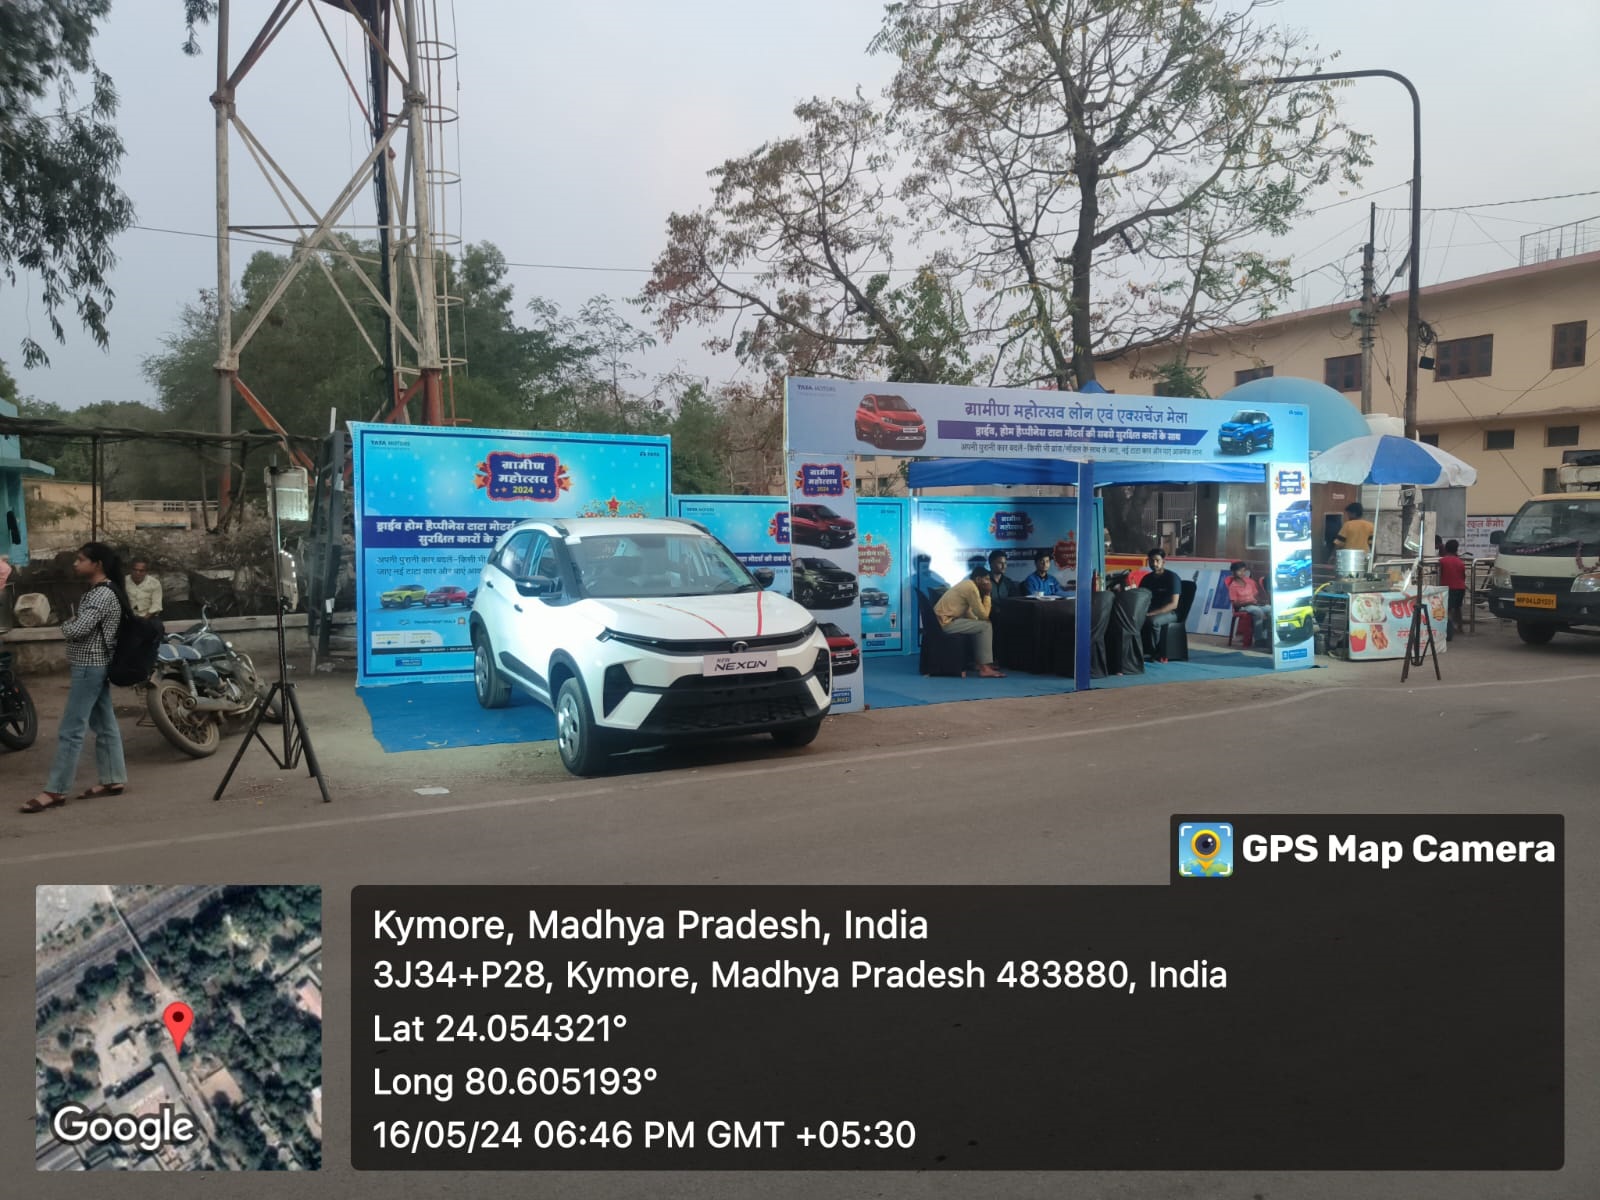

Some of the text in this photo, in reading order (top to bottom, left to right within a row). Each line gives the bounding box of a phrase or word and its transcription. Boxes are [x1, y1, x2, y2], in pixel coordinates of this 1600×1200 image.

[965, 398, 1188, 425] ग्रामीण महोत्सव लोन एवं एक्सचेंज मेला
[502, 459, 545, 472] ग्रामीण
[499, 472, 548, 484] महोत्सव
[512, 486, 534, 494] 2024
[376, 519, 402, 533] ड्राईव
[404, 519, 423, 531] होम
[425, 519, 465, 531] हैप्पीनेस
[467, 522, 487, 531] टाटा
[418, 532, 455, 546] सुरक्षित
[457, 532, 481, 544] कारों
[483, 533, 494, 543] के
[714, 660, 768, 672] NEXON
